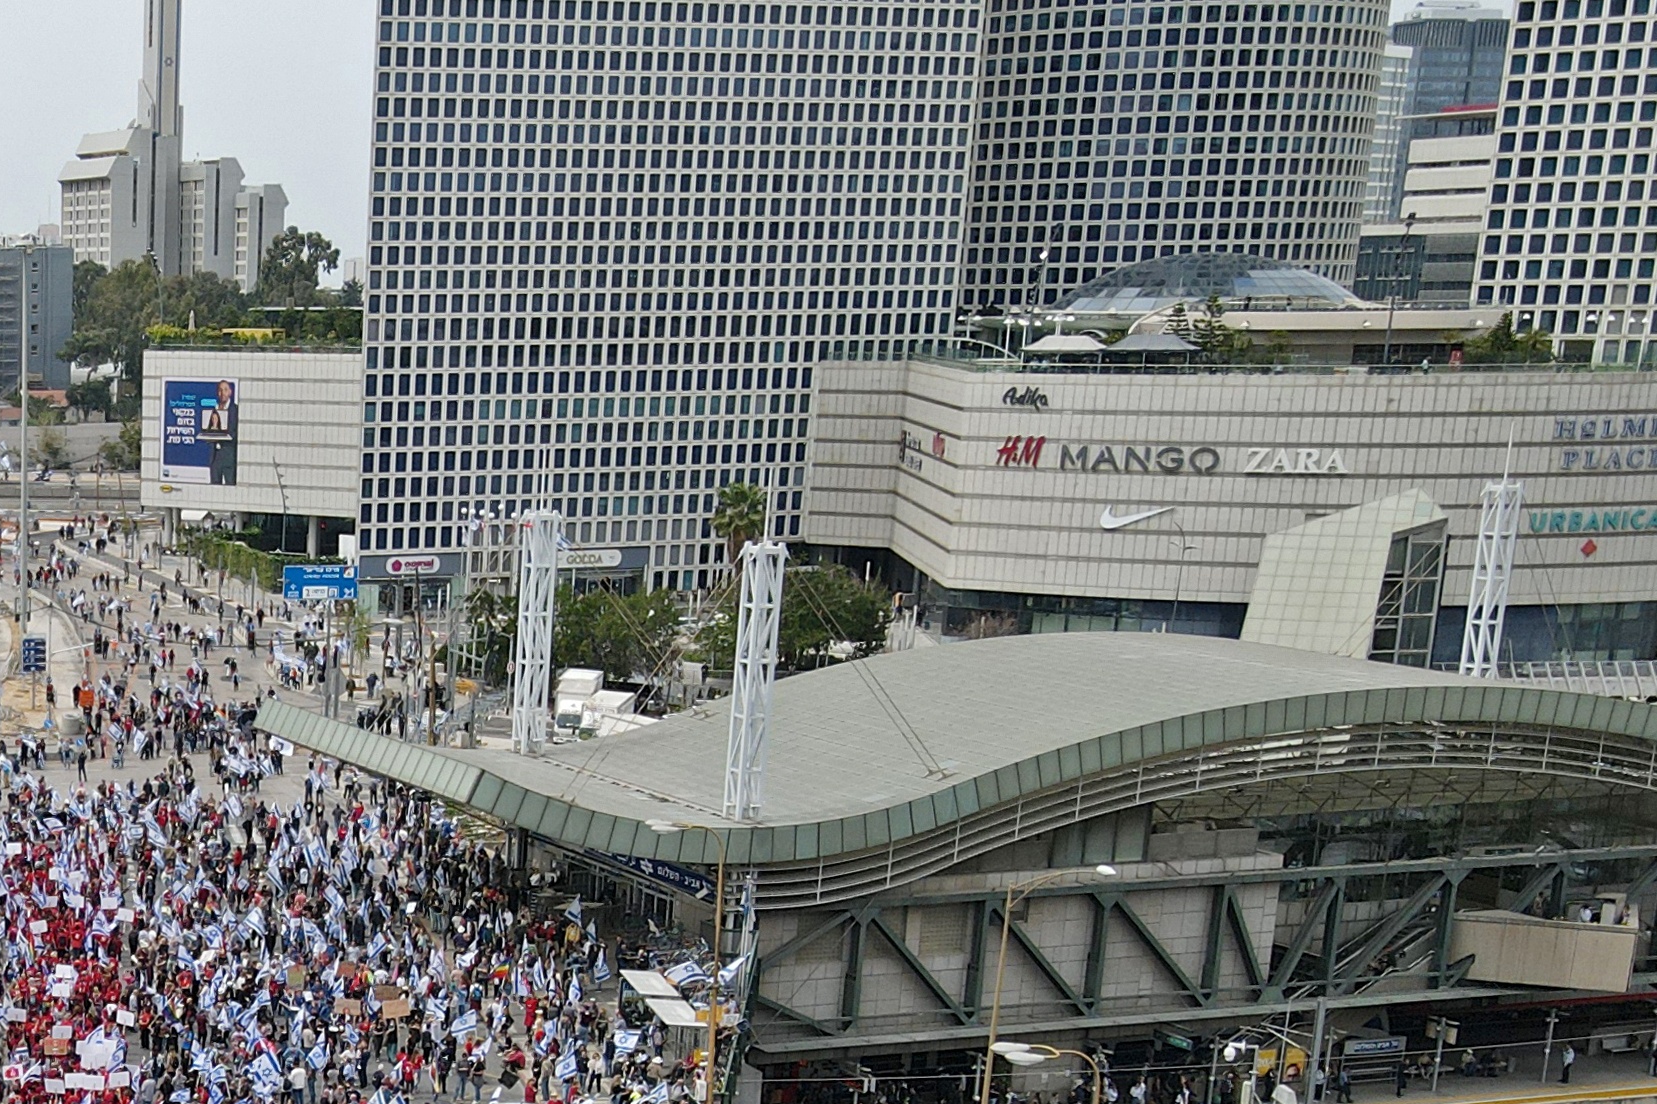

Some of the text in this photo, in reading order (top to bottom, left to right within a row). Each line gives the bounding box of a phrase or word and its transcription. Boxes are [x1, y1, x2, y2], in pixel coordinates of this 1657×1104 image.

[1002, 386, 1049, 412] Adika
[996, 434, 1046, 469] H&M
[1059, 443, 1221, 476] MANGO
[1244, 447, 1348, 474] ZARA
[1530, 509, 1657, 533] URBANICA
[566, 554, 603, 565] GOLDA
